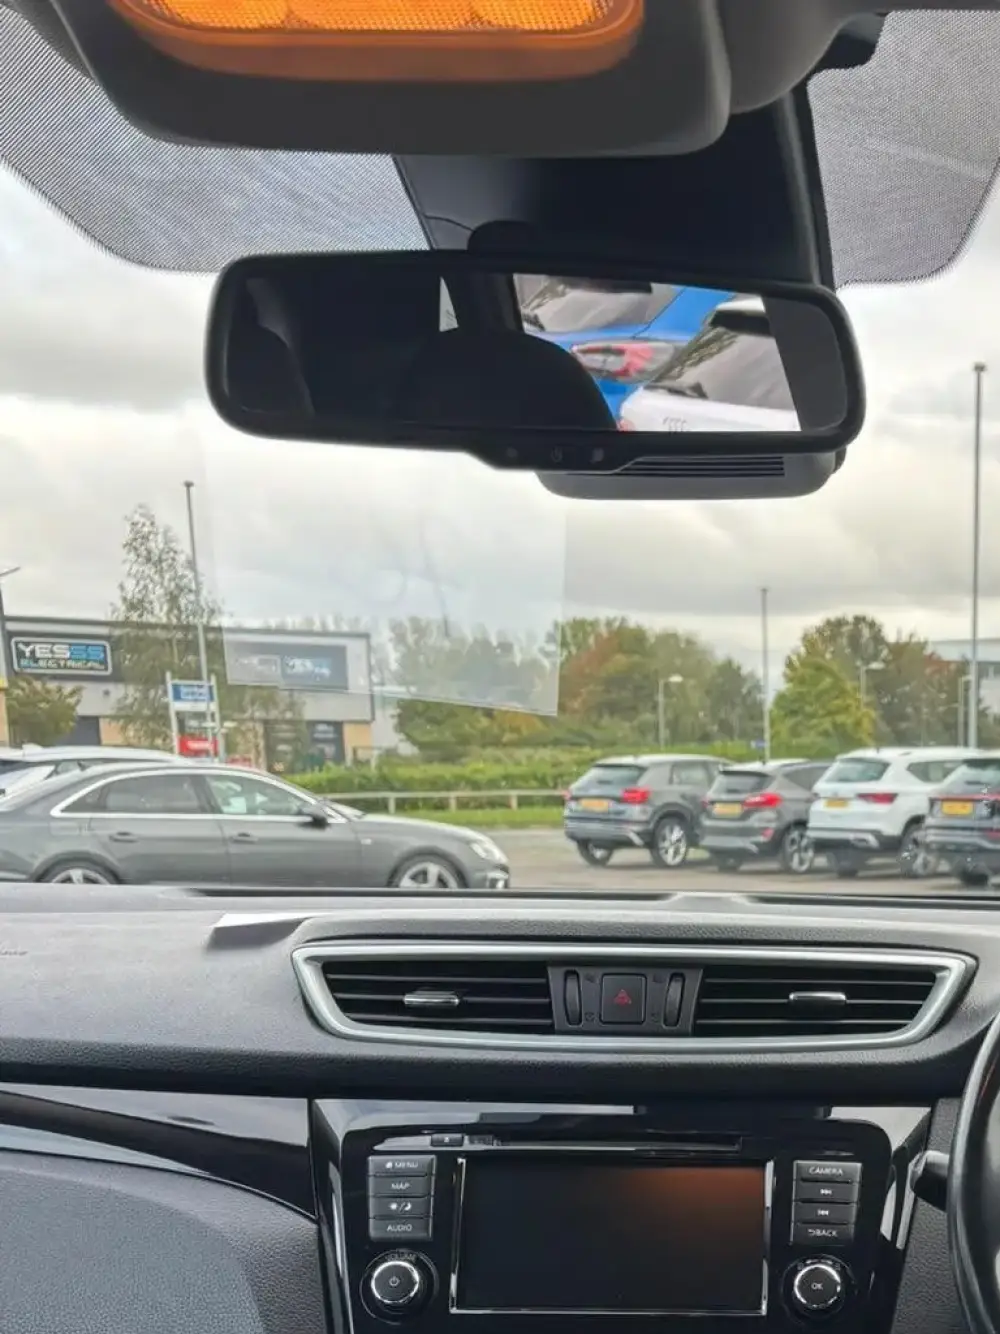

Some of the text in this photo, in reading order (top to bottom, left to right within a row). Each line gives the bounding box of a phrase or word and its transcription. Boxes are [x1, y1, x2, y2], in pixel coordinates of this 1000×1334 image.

[395, 1161, 418, 1169] MENU
[809, 1166, 844, 1176] CAMERA
[391, 1182, 411, 1190] MAP
[386, 1223, 413, 1232] AUDIO
[815, 1228, 838, 1238] BACK
[811, 1282, 824, 1291] OK
